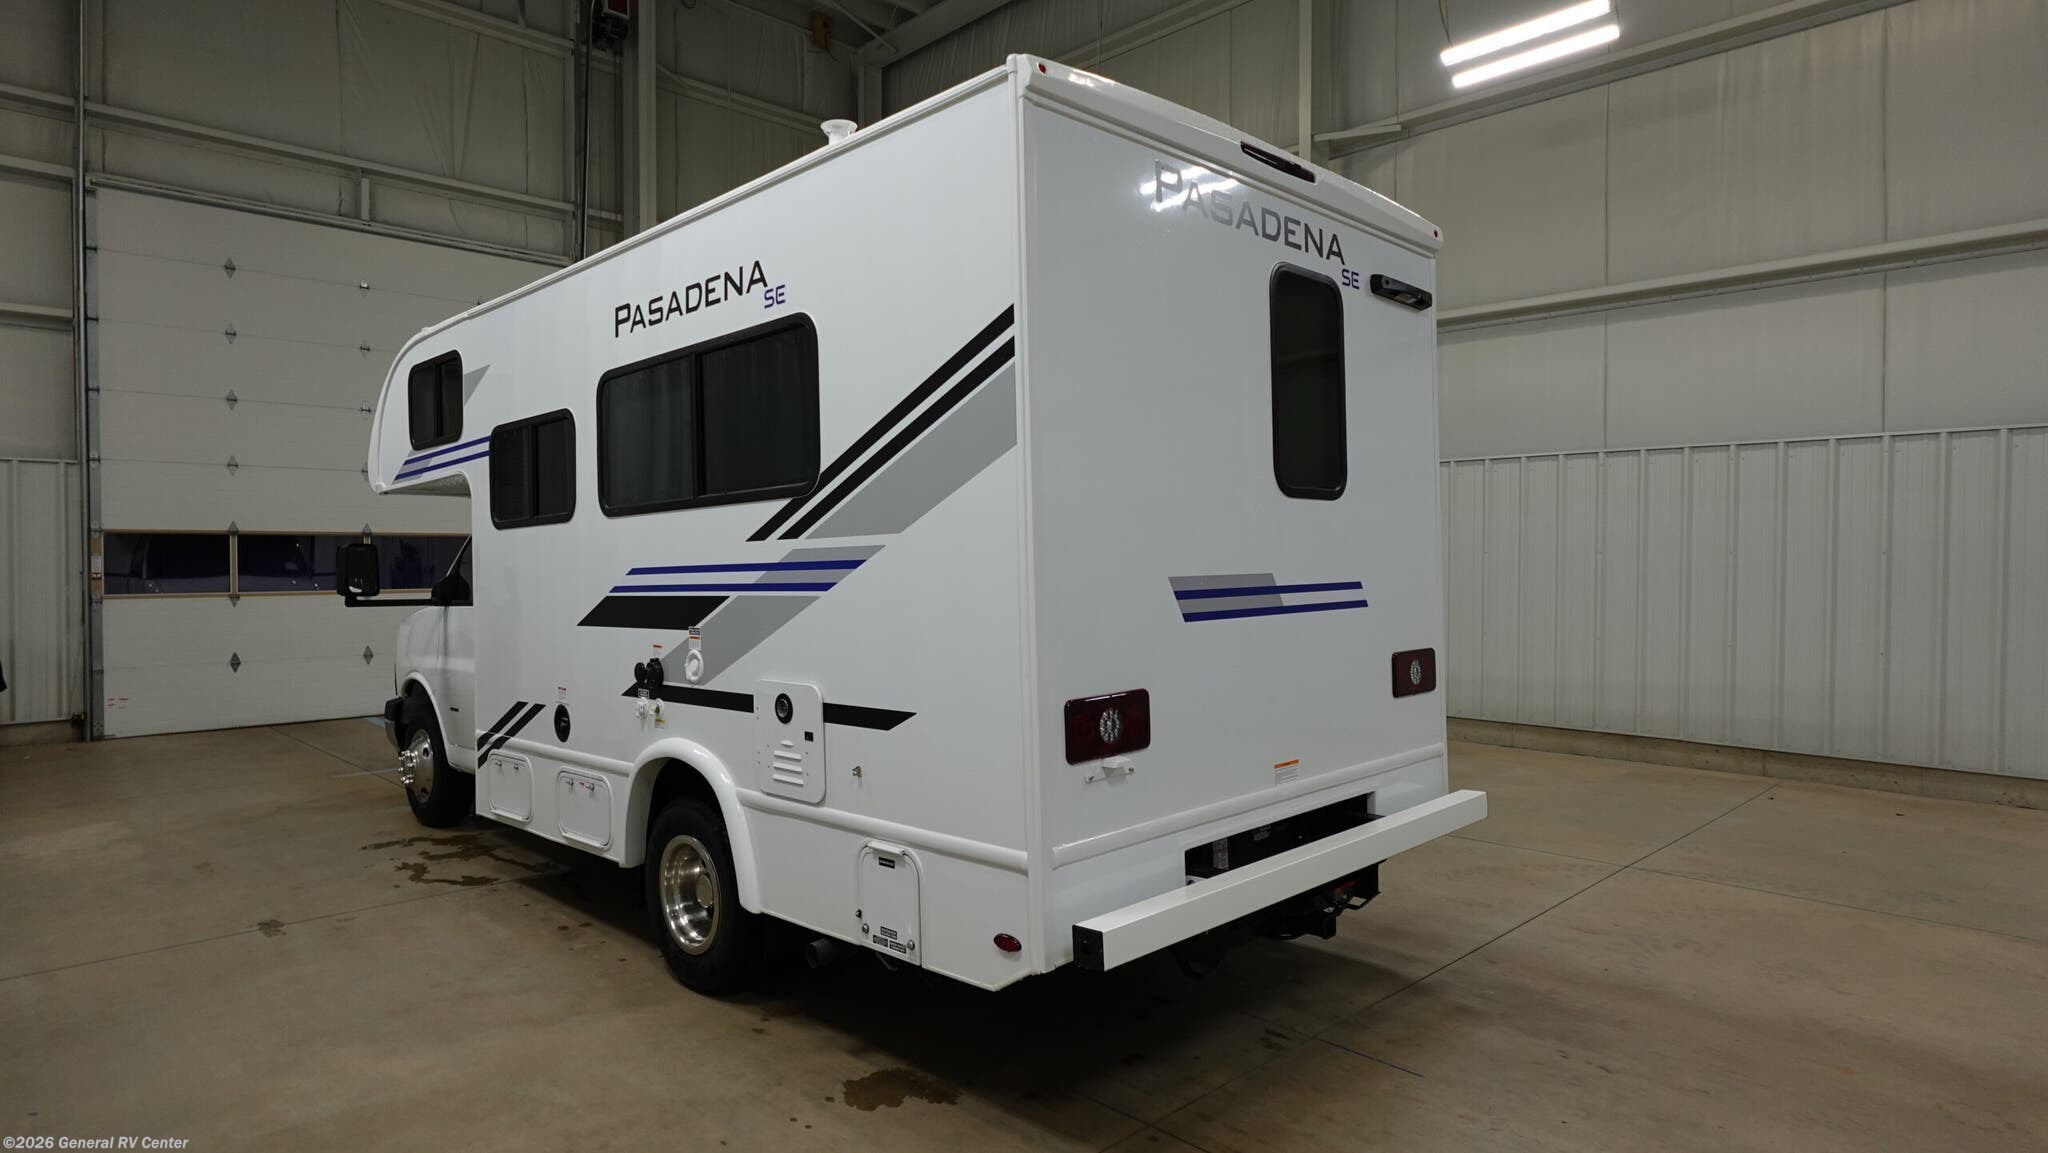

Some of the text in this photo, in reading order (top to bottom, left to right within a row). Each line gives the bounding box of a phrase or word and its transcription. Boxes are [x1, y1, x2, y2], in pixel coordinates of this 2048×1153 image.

[1154, 158, 1346, 266] PASADENA
[614, 259, 768, 339] PASADENA
[763, 284, 786, 309] SE
[1341, 268, 1360, 290] SE
